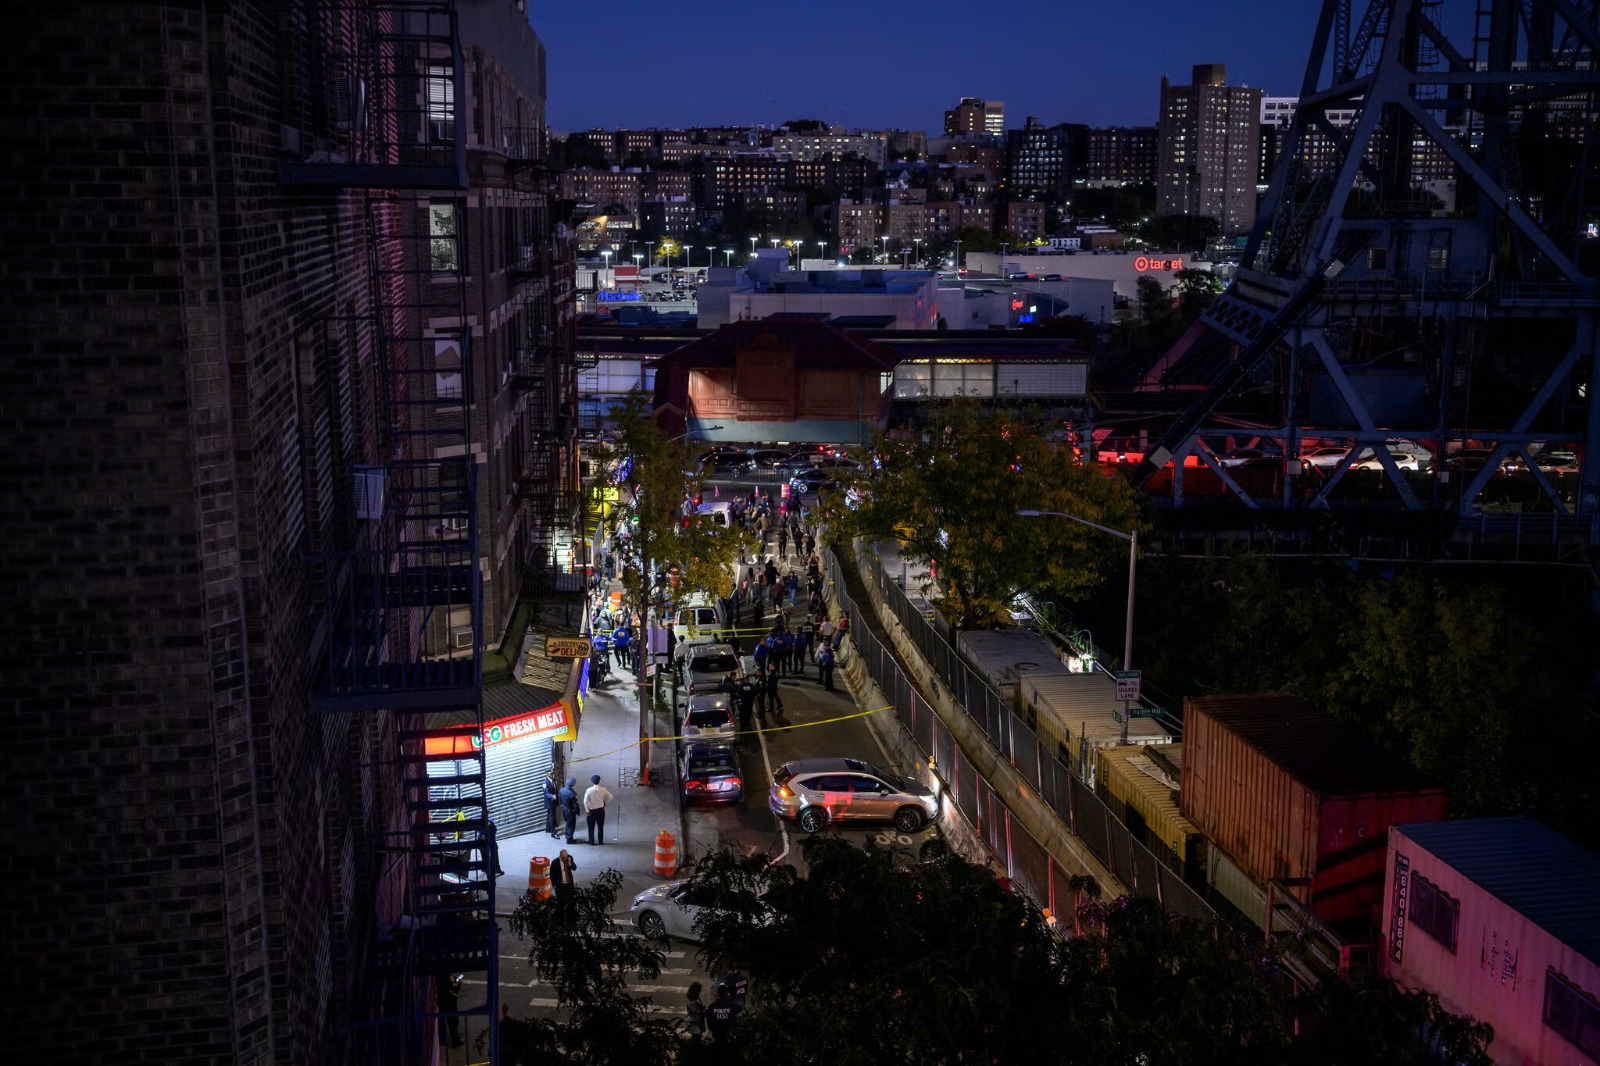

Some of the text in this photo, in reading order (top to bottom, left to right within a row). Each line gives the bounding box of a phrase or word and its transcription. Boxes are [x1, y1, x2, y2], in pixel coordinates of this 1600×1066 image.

[1149, 258, 1183, 271] target
[561, 648, 577, 656] DELI
[503, 720, 537, 739] FRESH
[537, 711, 564, 728] MEAT
